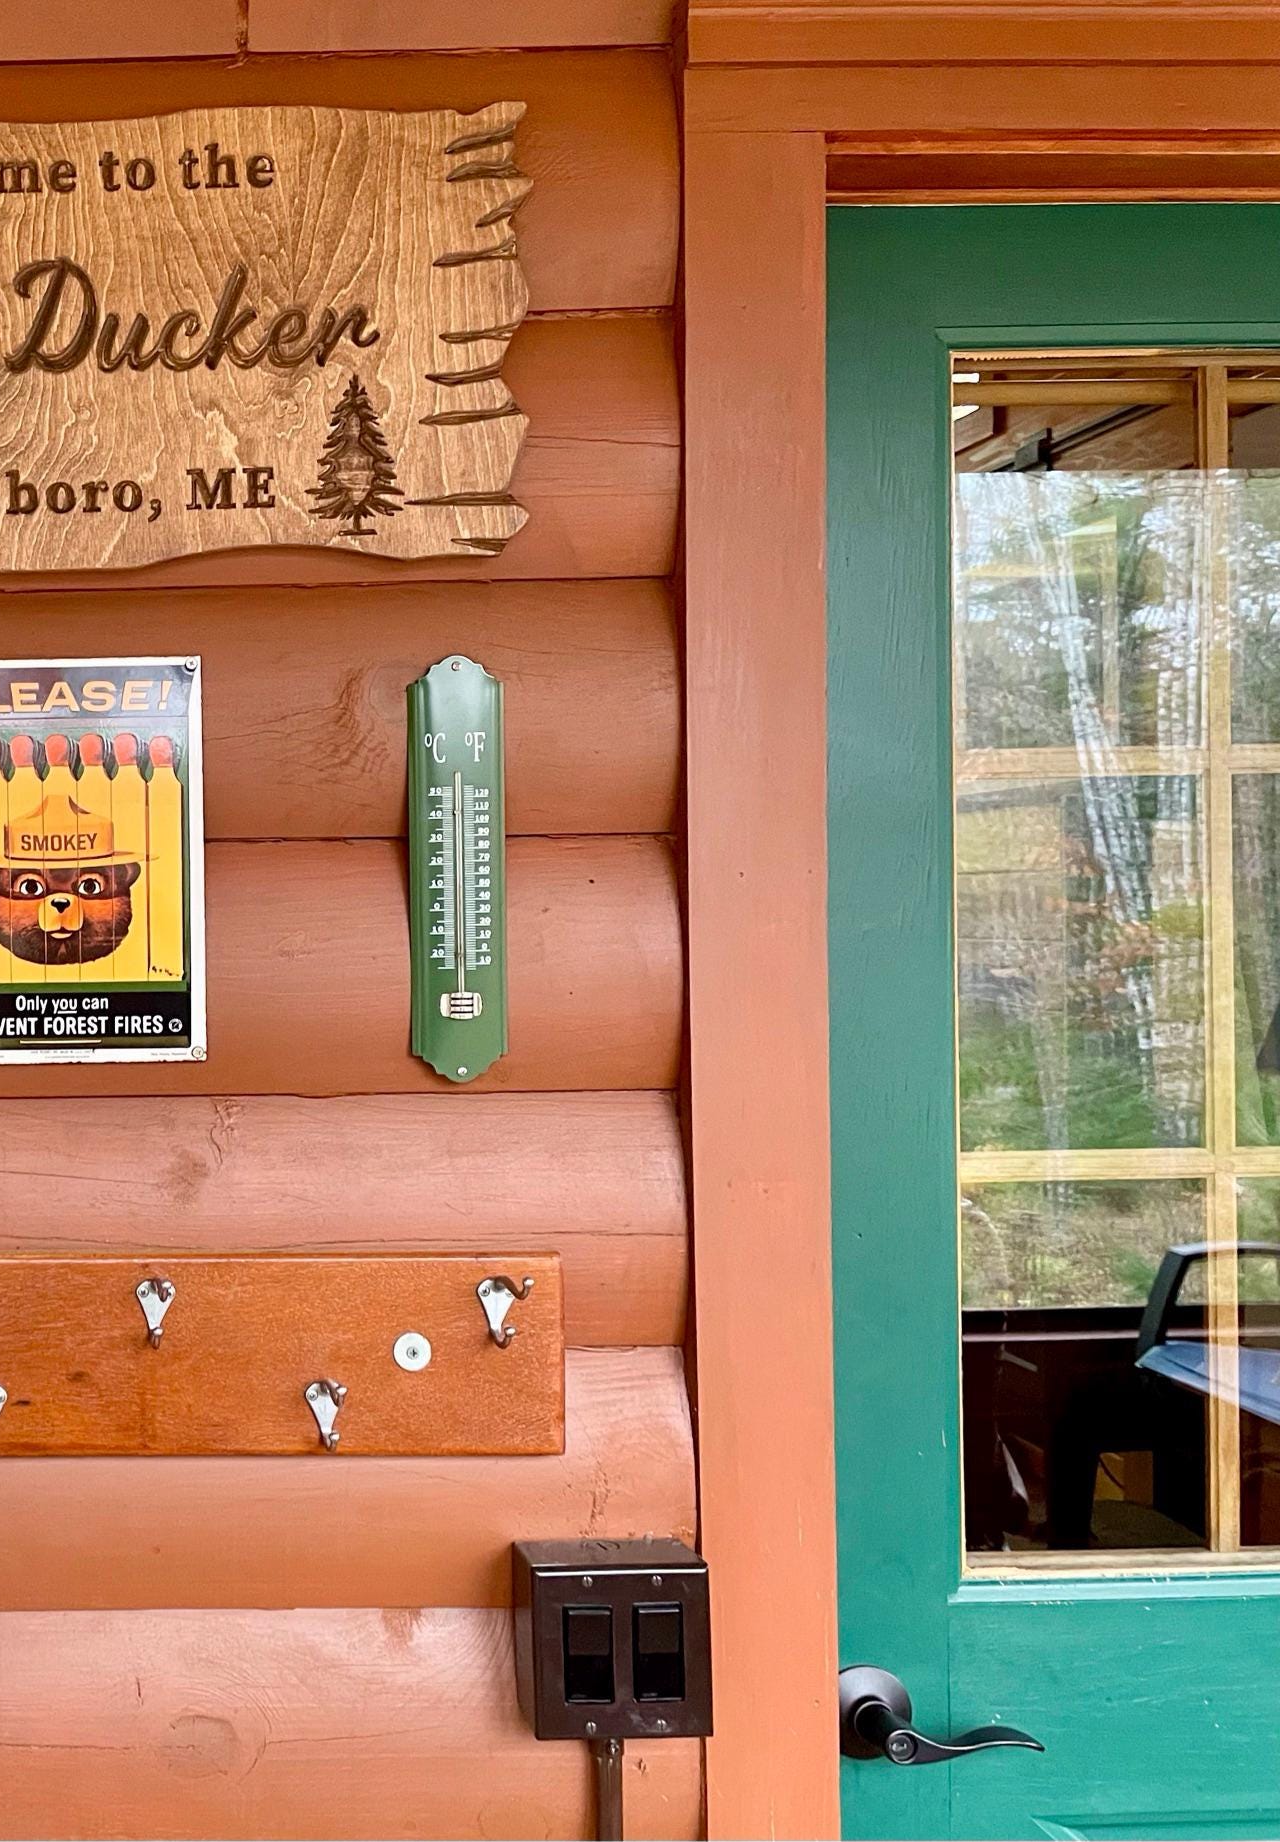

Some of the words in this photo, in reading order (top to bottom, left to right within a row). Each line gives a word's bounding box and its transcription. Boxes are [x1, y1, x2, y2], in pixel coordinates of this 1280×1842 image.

[100, 151, 156, 193] to
[179, 142, 276, 190] the
[3, 256, 381, 374] Ducker
[187, 467, 277, 513] ME
[21, 833, 98, 852] SMOKEY
[16, 995, 47, 1015] Only
[51, 998, 78, 1015] you
[82, 996, 109, 1010] can
[43, 1016, 109, 1035] FOREST
[114, 1015, 164, 1034] FIRES
